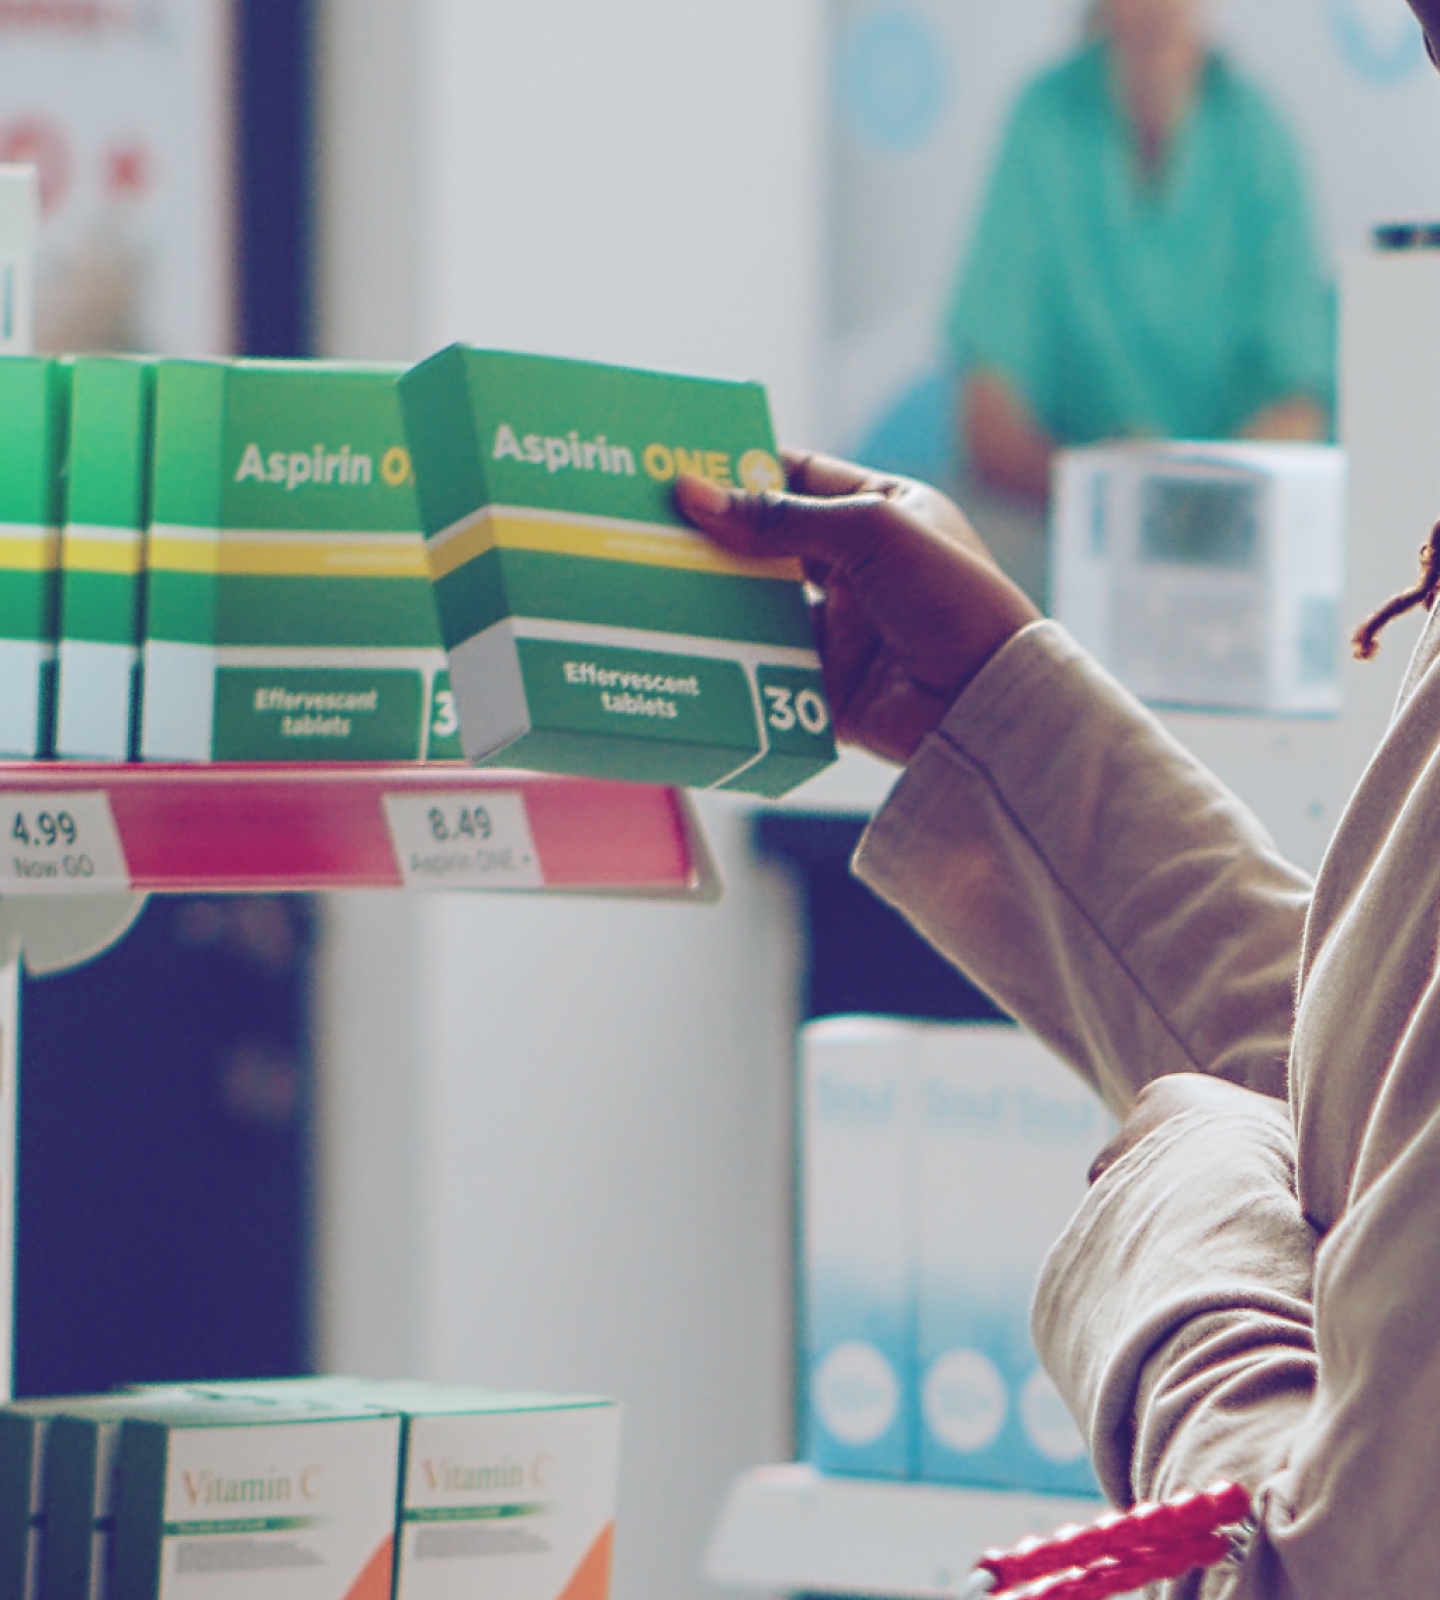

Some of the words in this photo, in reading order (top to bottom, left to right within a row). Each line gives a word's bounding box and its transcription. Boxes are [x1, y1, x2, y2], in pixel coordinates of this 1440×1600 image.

[235, 441, 372, 491] Aspirin
[492, 423, 636, 478] Aspirin
[642, 442, 731, 488] ONE
[563, 660, 700, 697] Effervescent
[254, 686, 378, 713] Effervescent
[600, 690, 679, 720] tablets
[763, 685, 830, 734] 30
[280, 712, 352, 738] tablets
[12, 810, 78, 846] 4.99
[428, 805, 492, 841] 8.49
[13, 856, 58, 878] Now
[61, 854, 95, 878] GO
[181, 1466, 292, 1506] Vitamin
[300, 1464, 324, 1500] C
[421, 1454, 526, 1493] Vitamin
[531, 1451, 553, 1488] C
